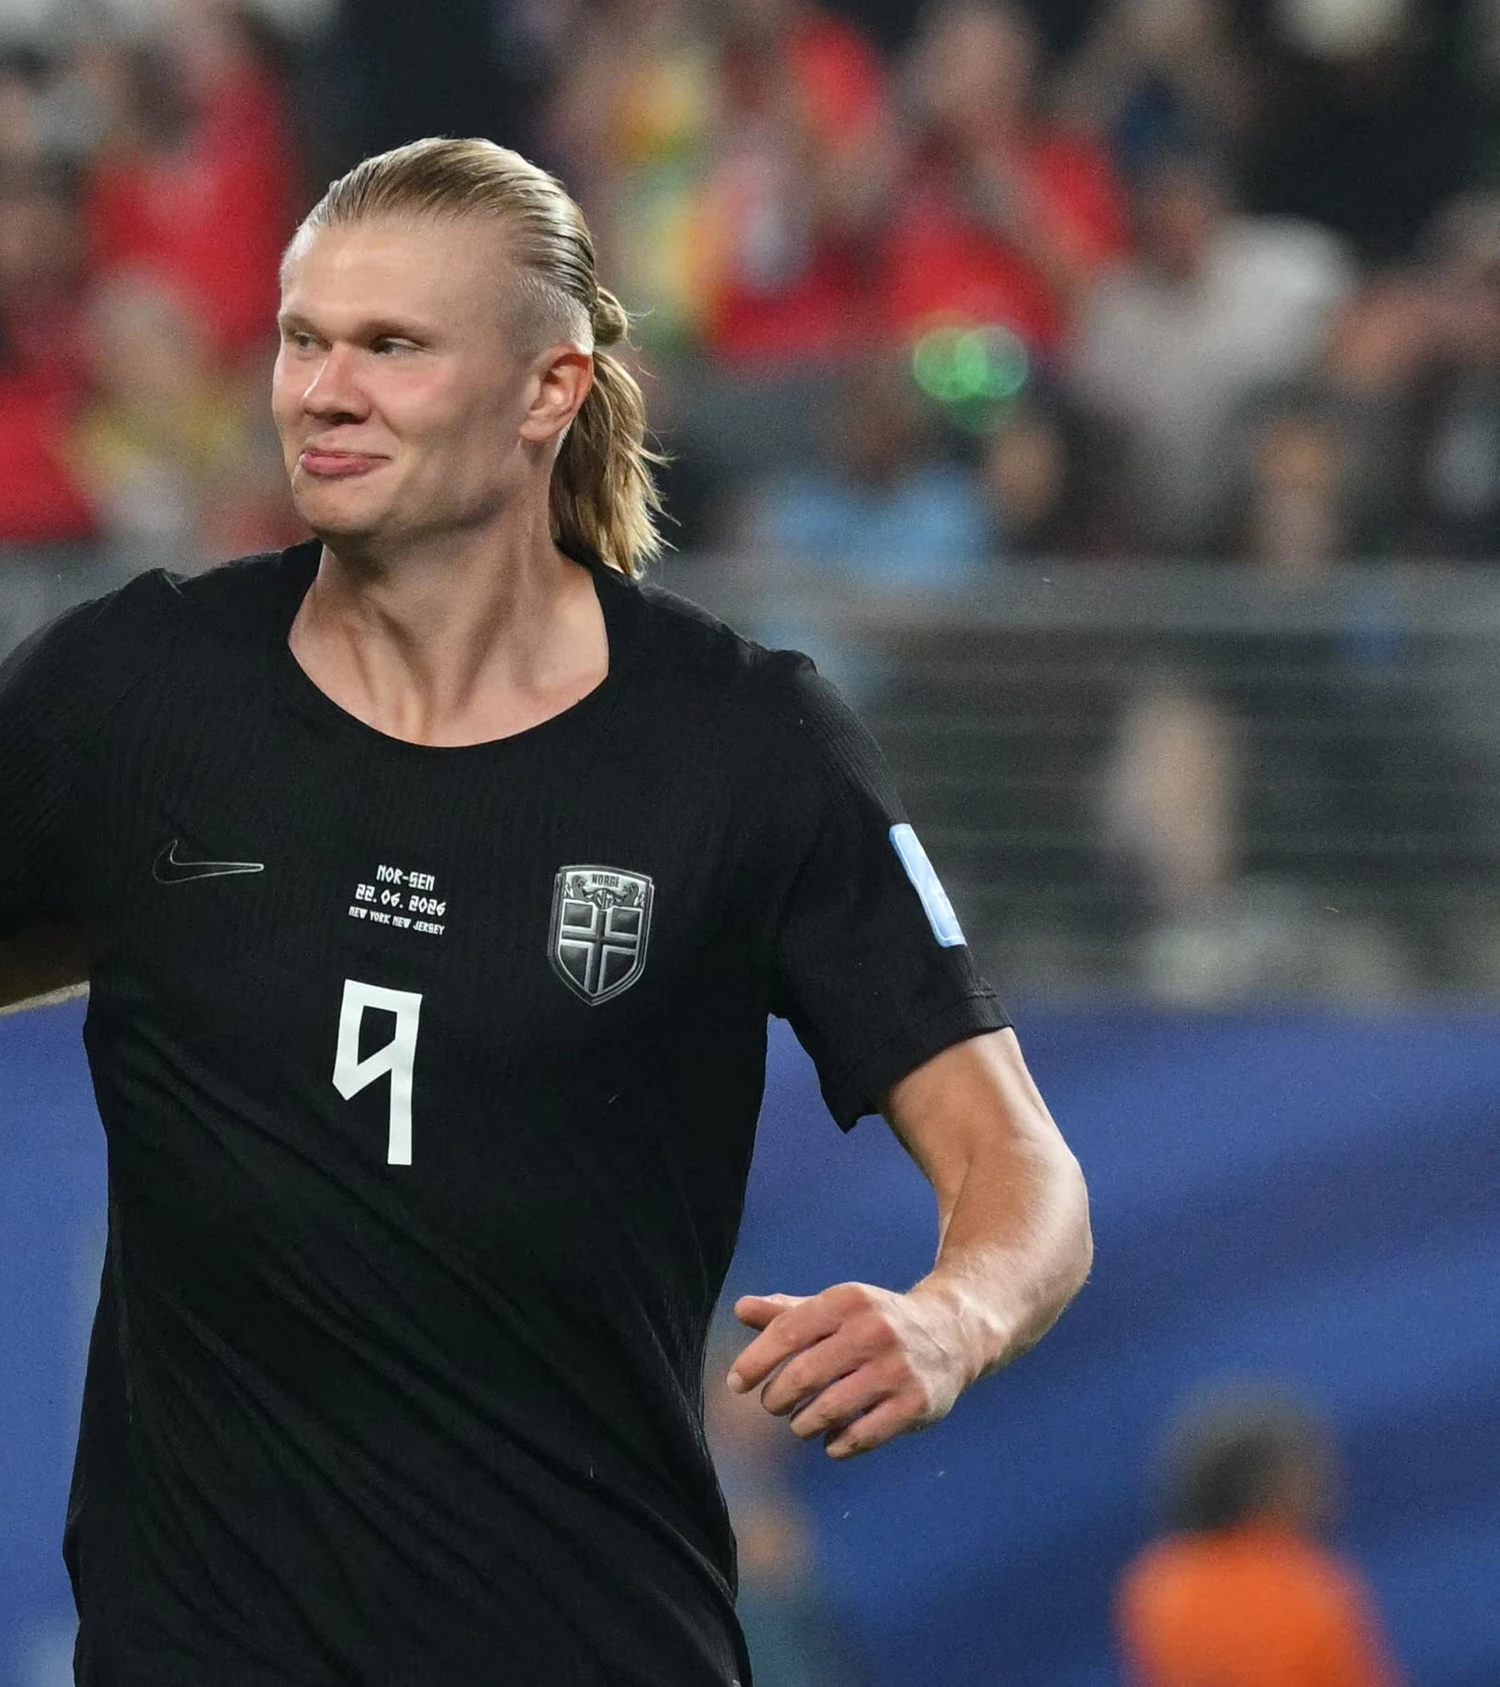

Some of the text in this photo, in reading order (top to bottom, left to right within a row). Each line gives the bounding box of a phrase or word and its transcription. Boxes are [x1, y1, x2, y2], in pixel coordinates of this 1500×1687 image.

[376, 864, 435, 892] NOR-SEN
[591, 874, 621, 888] NORGE
[348, 905, 445, 935] NEW YORK NEW JERSEY
[332, 978, 423, 1166] 9
